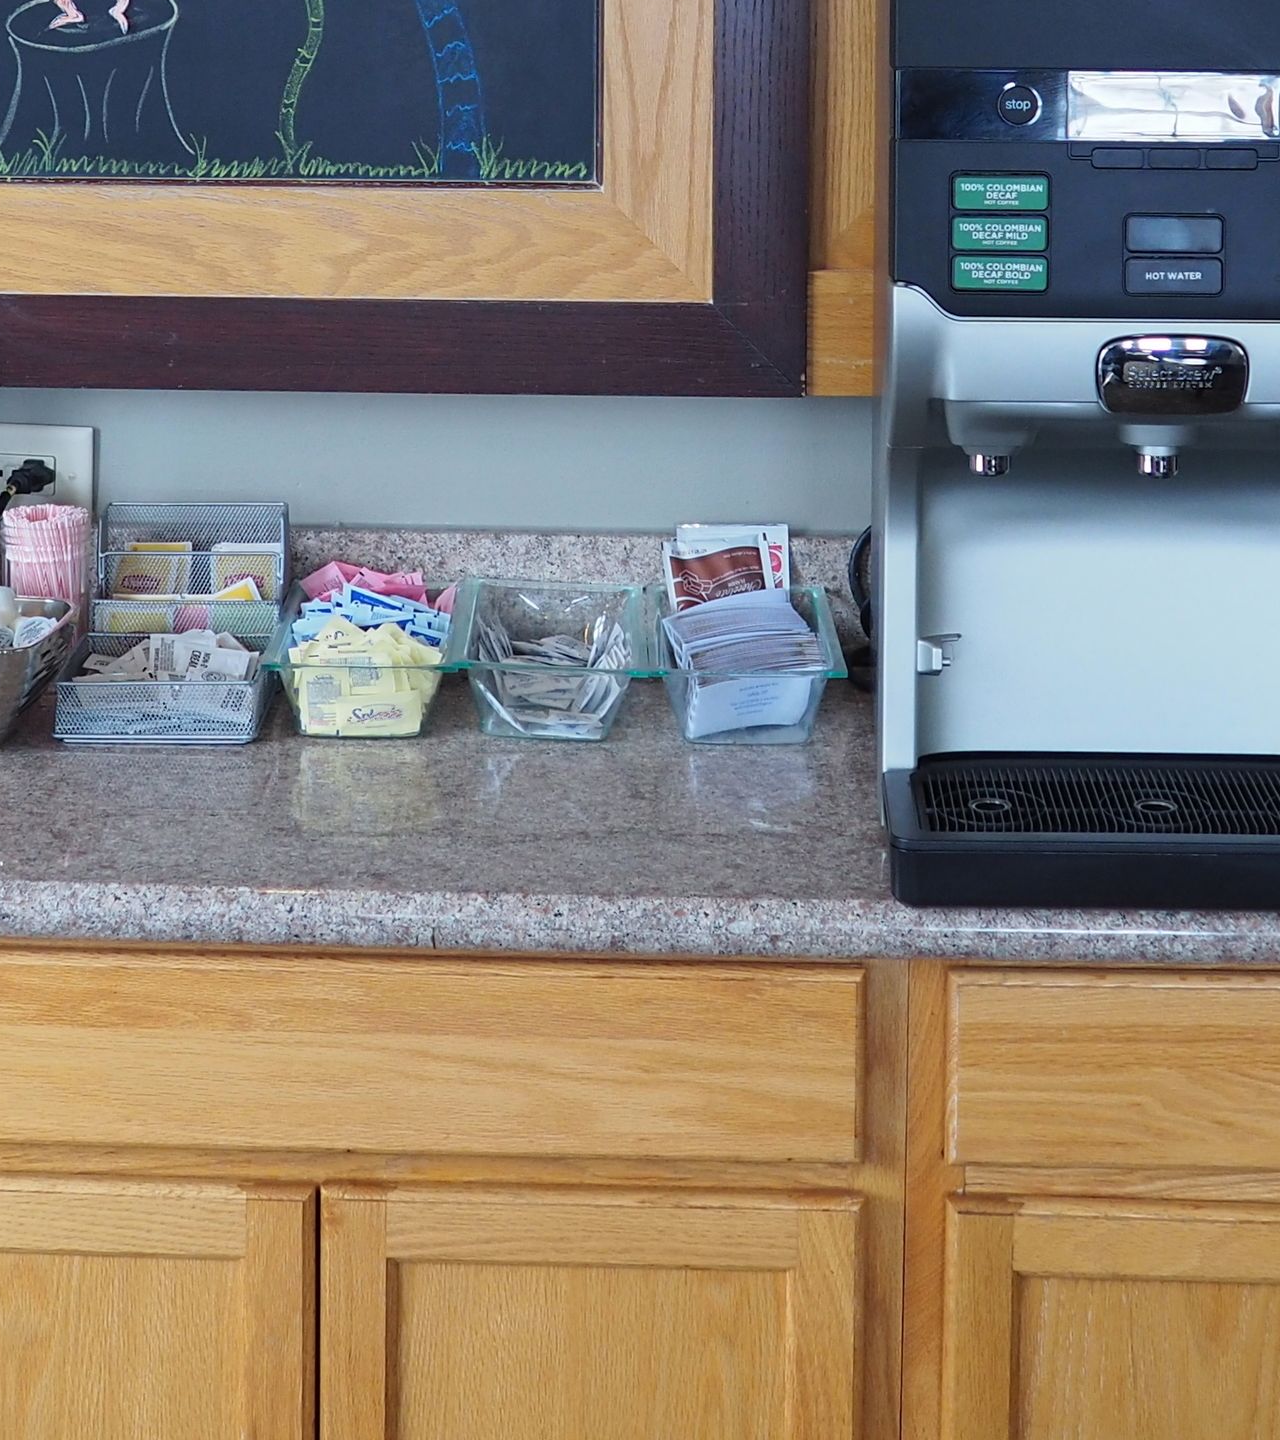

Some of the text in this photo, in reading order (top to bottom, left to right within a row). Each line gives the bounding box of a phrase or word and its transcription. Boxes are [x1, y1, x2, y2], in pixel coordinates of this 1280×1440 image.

[1005, 98, 1031, 112] stop
[960, 184, 1043, 193] 100% COLOMBIAN
[986, 191, 1018, 199] DECAF
[959, 223, 1042, 233] 100% COLOMBIAN
[972, 231, 1028, 240] DECAF MILD
[960, 262, 1043, 272] 100% COLOMBIAN
[971, 270, 1031, 280] DECAF BOLD
[1145, 271, 1202, 280] HOT WATER
